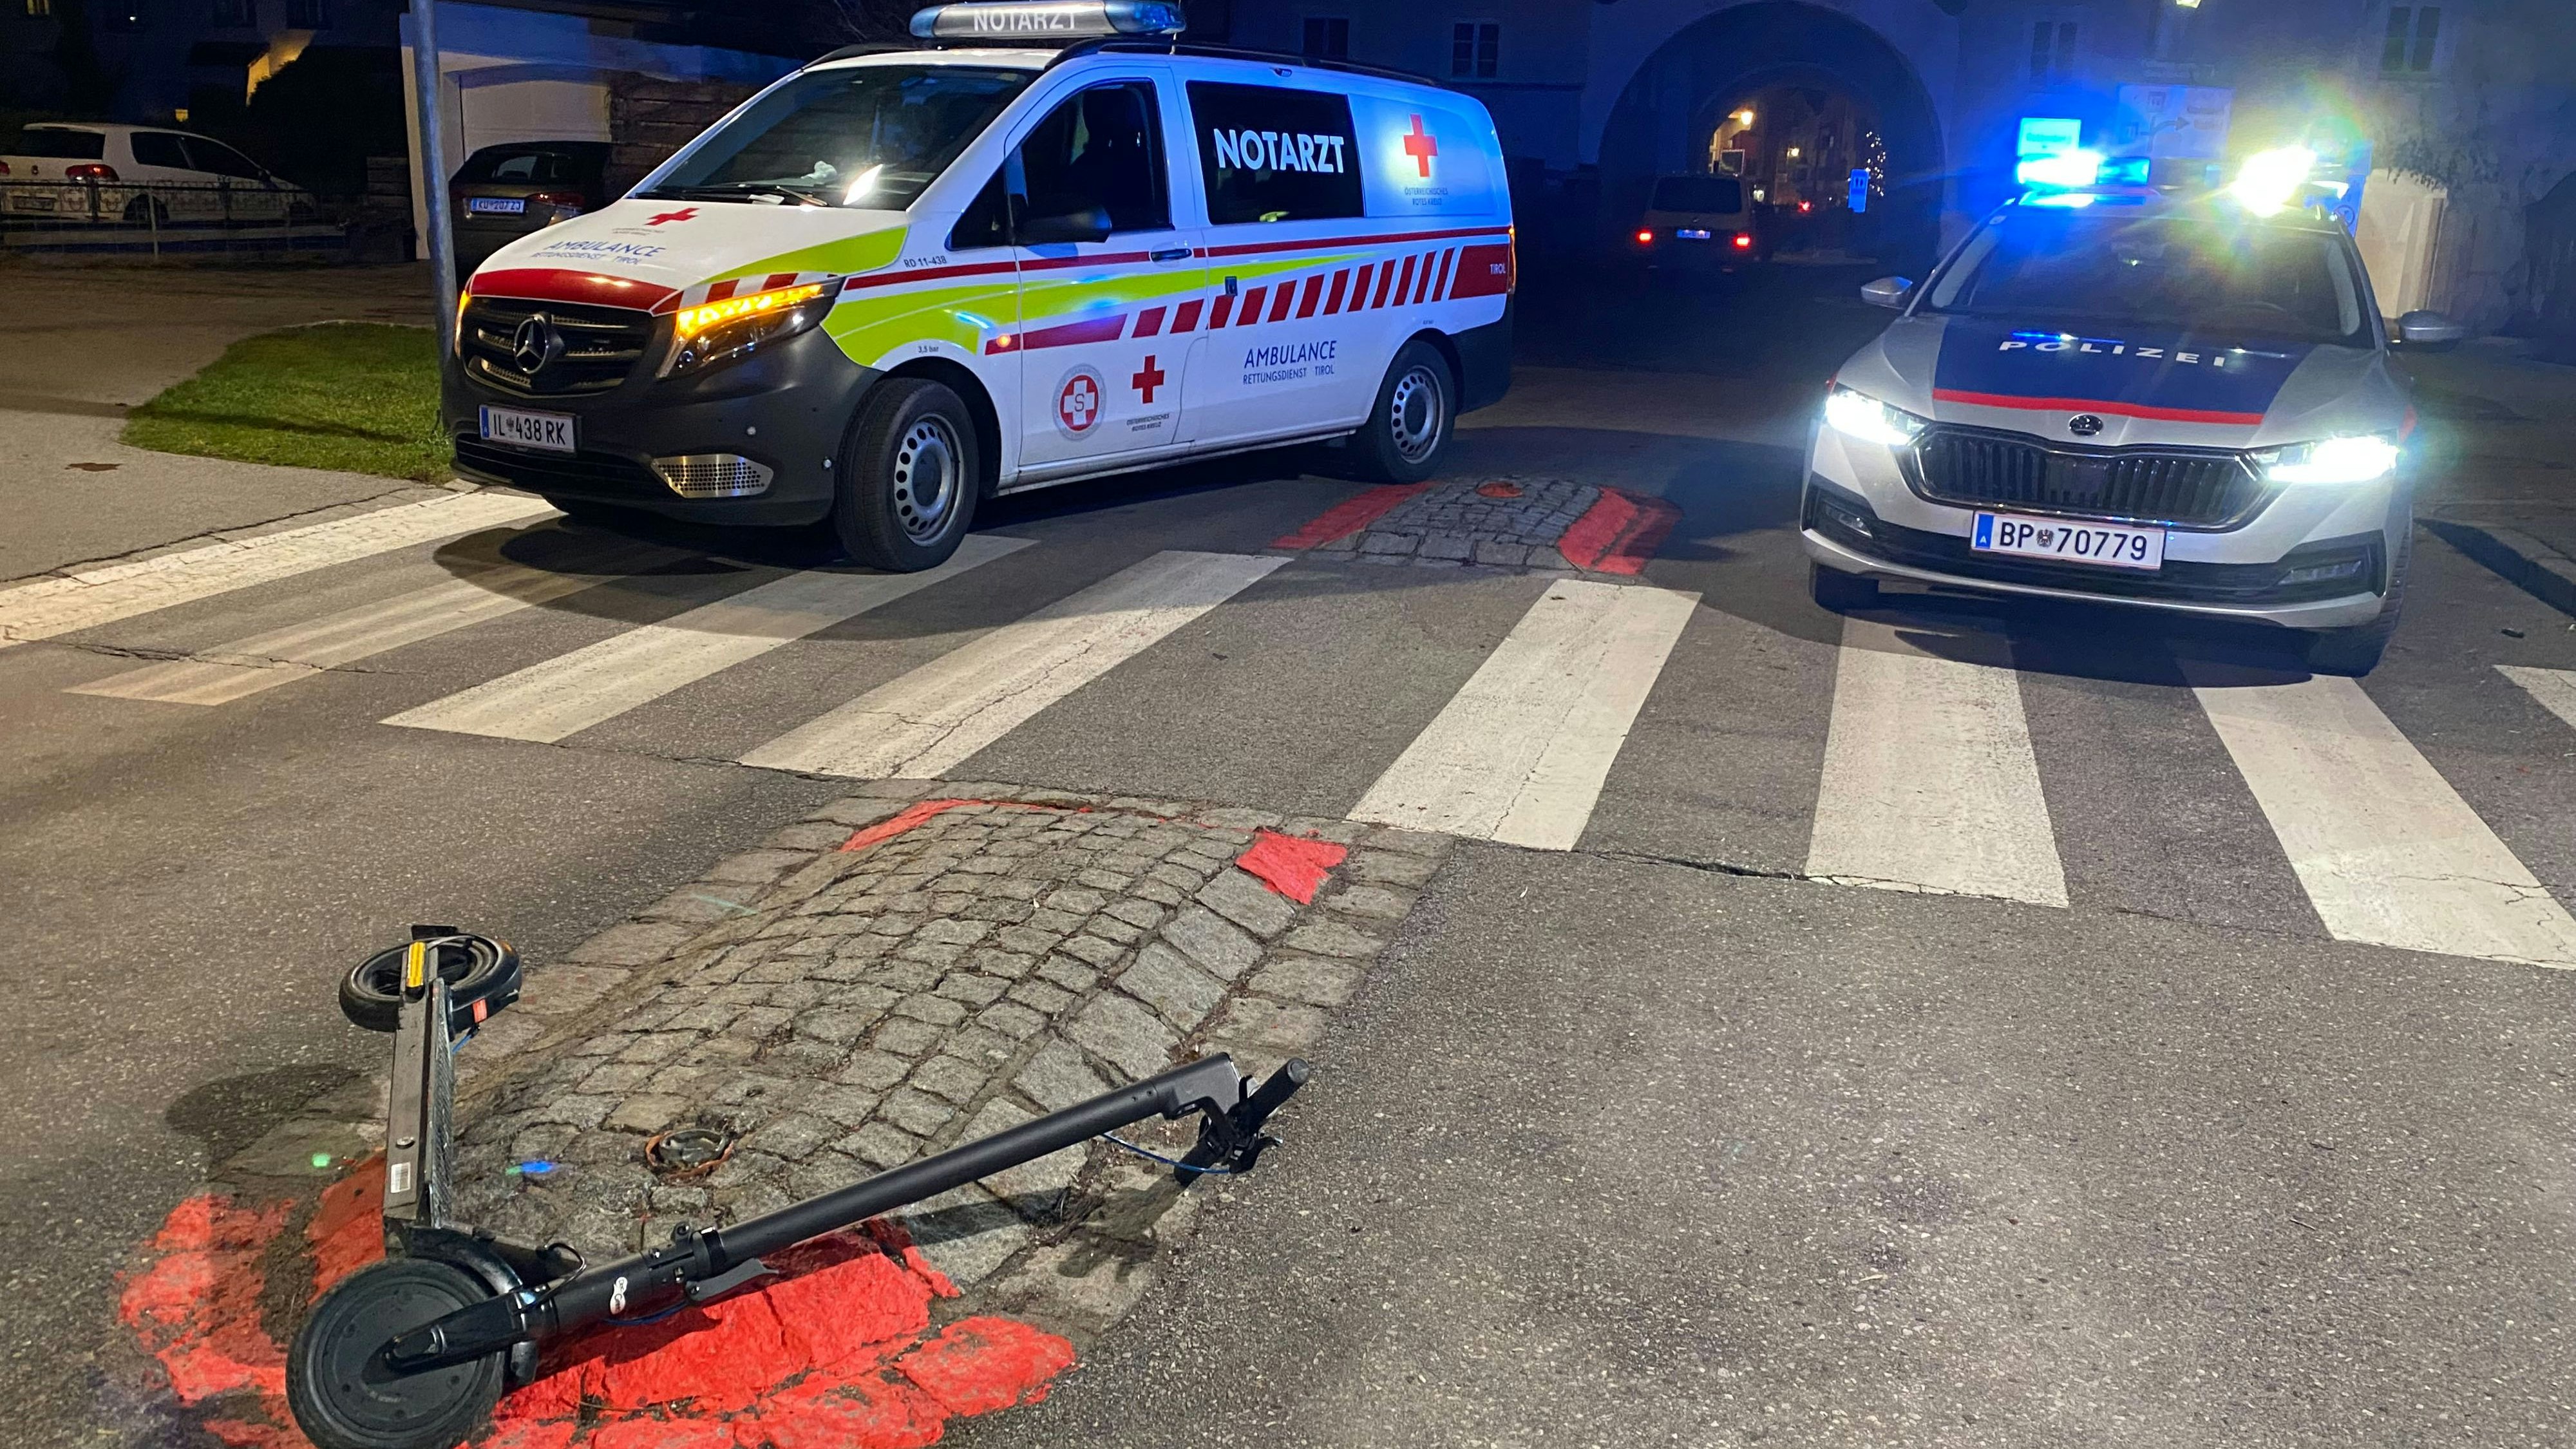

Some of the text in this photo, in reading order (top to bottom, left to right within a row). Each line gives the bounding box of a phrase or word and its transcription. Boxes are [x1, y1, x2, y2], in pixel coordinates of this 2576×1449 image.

[973, 11, 1075, 32] NOTARZT
[1213, 128, 1345, 174] NOTARZT
[543, 241, 667, 257] AMBULANCE
[904, 255, 947, 267] RD 11-438
[1490, 263, 1506, 274] TIROL
[1244, 340, 1337, 369] AMBULANCE
[1998, 341, 2226, 367] POLIZEI
[1243, 365, 1335, 385] RETTUNGSDIENST TIROL
[1074, 393, 1084, 412] S
[493, 414, 566, 446] IL 438 RK
[1980, 535, 1987, 544] A
[1999, 522, 2148, 561] BP 70779
